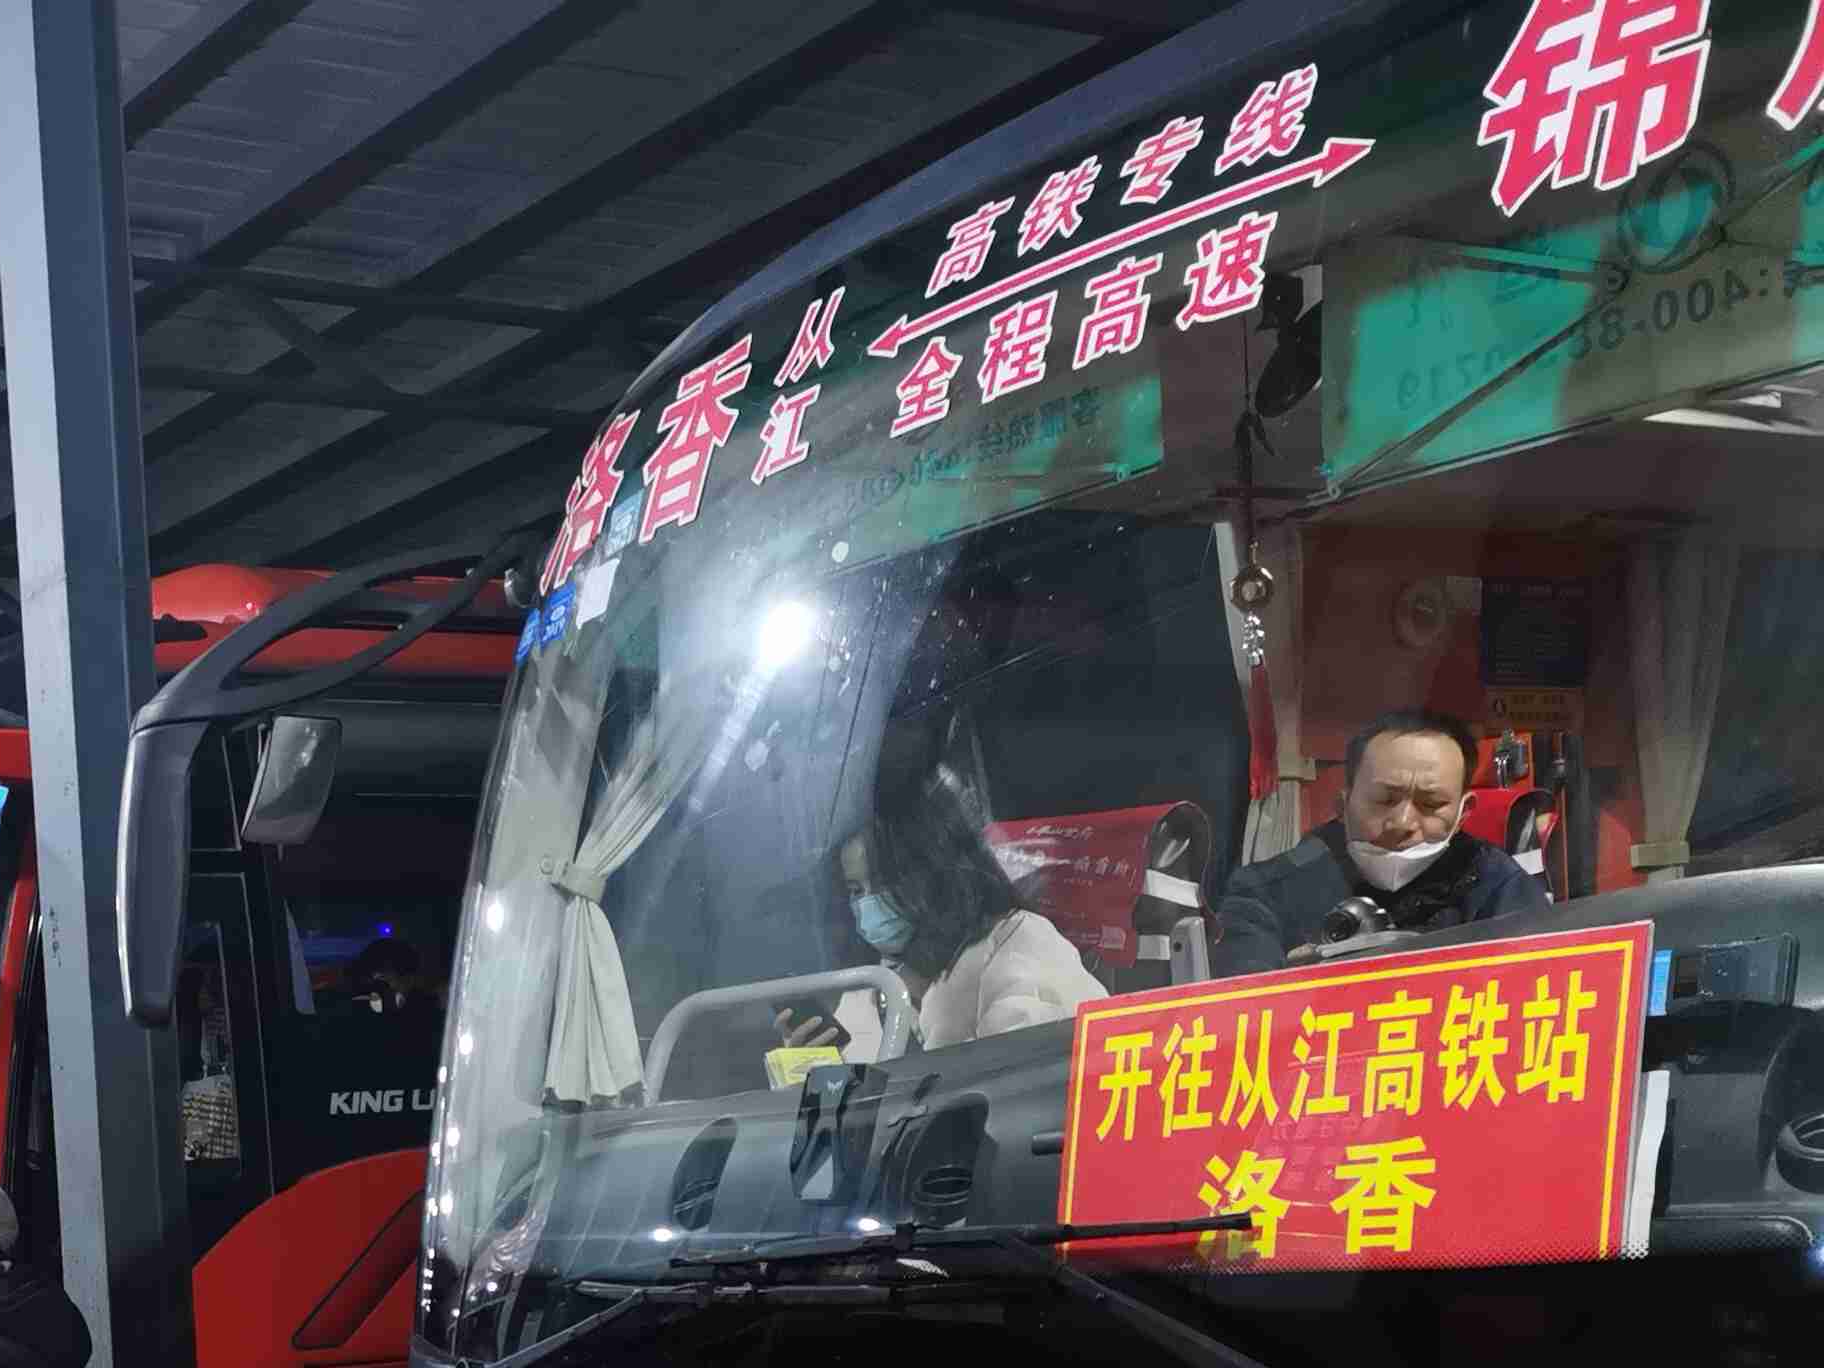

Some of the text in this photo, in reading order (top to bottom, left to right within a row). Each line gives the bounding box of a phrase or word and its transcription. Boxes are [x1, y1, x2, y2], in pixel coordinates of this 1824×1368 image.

[925, 63, 1319, 299] 高铁专线
[889, 211, 1279, 439] 全程高速
[539, 332, 753, 597] 洛香
[329, 1090, 404, 1115] KING
[1096, 971, 1598, 1143] 开往从江高铁站
[1197, 1136, 1437, 1260] 洛香
